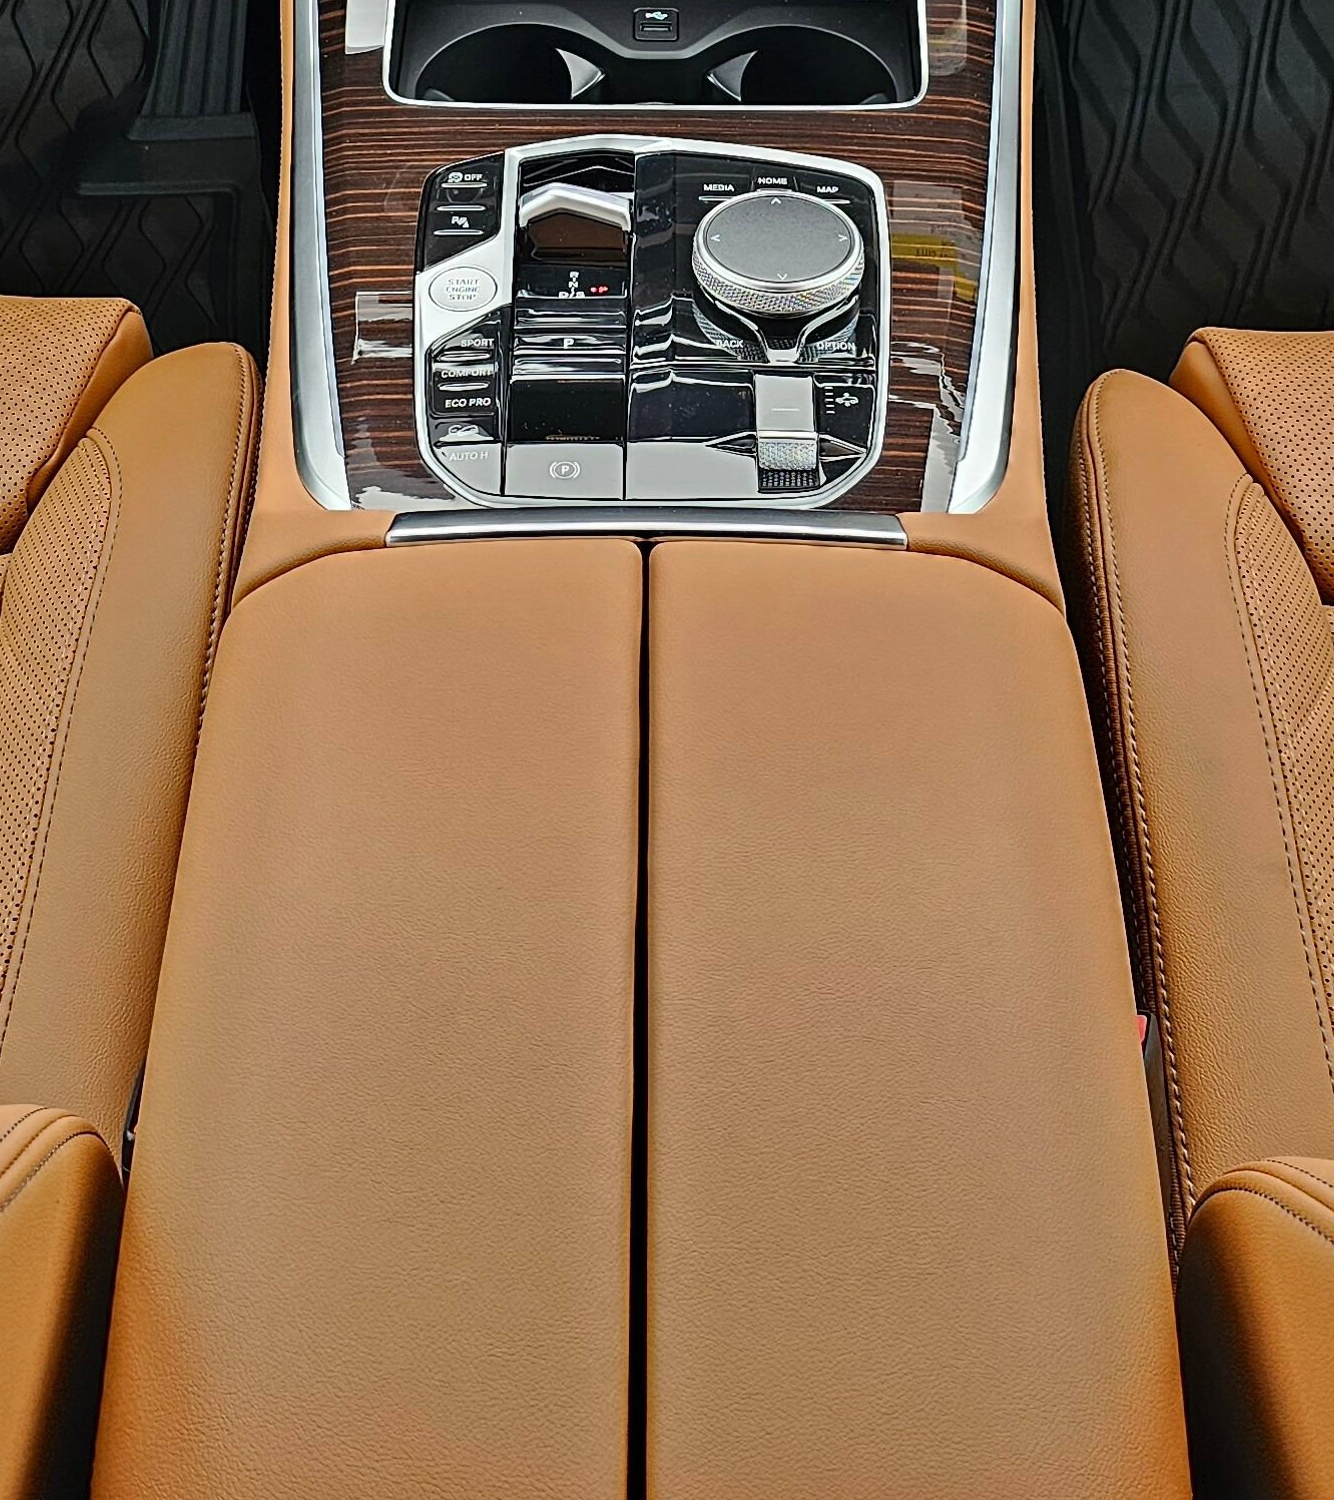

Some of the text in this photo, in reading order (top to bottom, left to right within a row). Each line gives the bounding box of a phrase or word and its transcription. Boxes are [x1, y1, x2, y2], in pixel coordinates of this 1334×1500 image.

[464, 173, 483, 181] OFF
[757, 176, 788, 186] HOME
[703, 183, 735, 192] MEDIA
[816, 185, 839, 194] MAP
[447, 278, 480, 286] START
[445, 285, 480, 294] ENGINE
[448, 293, 477, 301] STOP
[460, 338, 495, 348] SPORT
[563, 338, 575, 350] P
[817, 341, 856, 352] OPTION
[445, 397, 492, 409] ECO PRO
[448, 451, 489, 462] AUTO H
